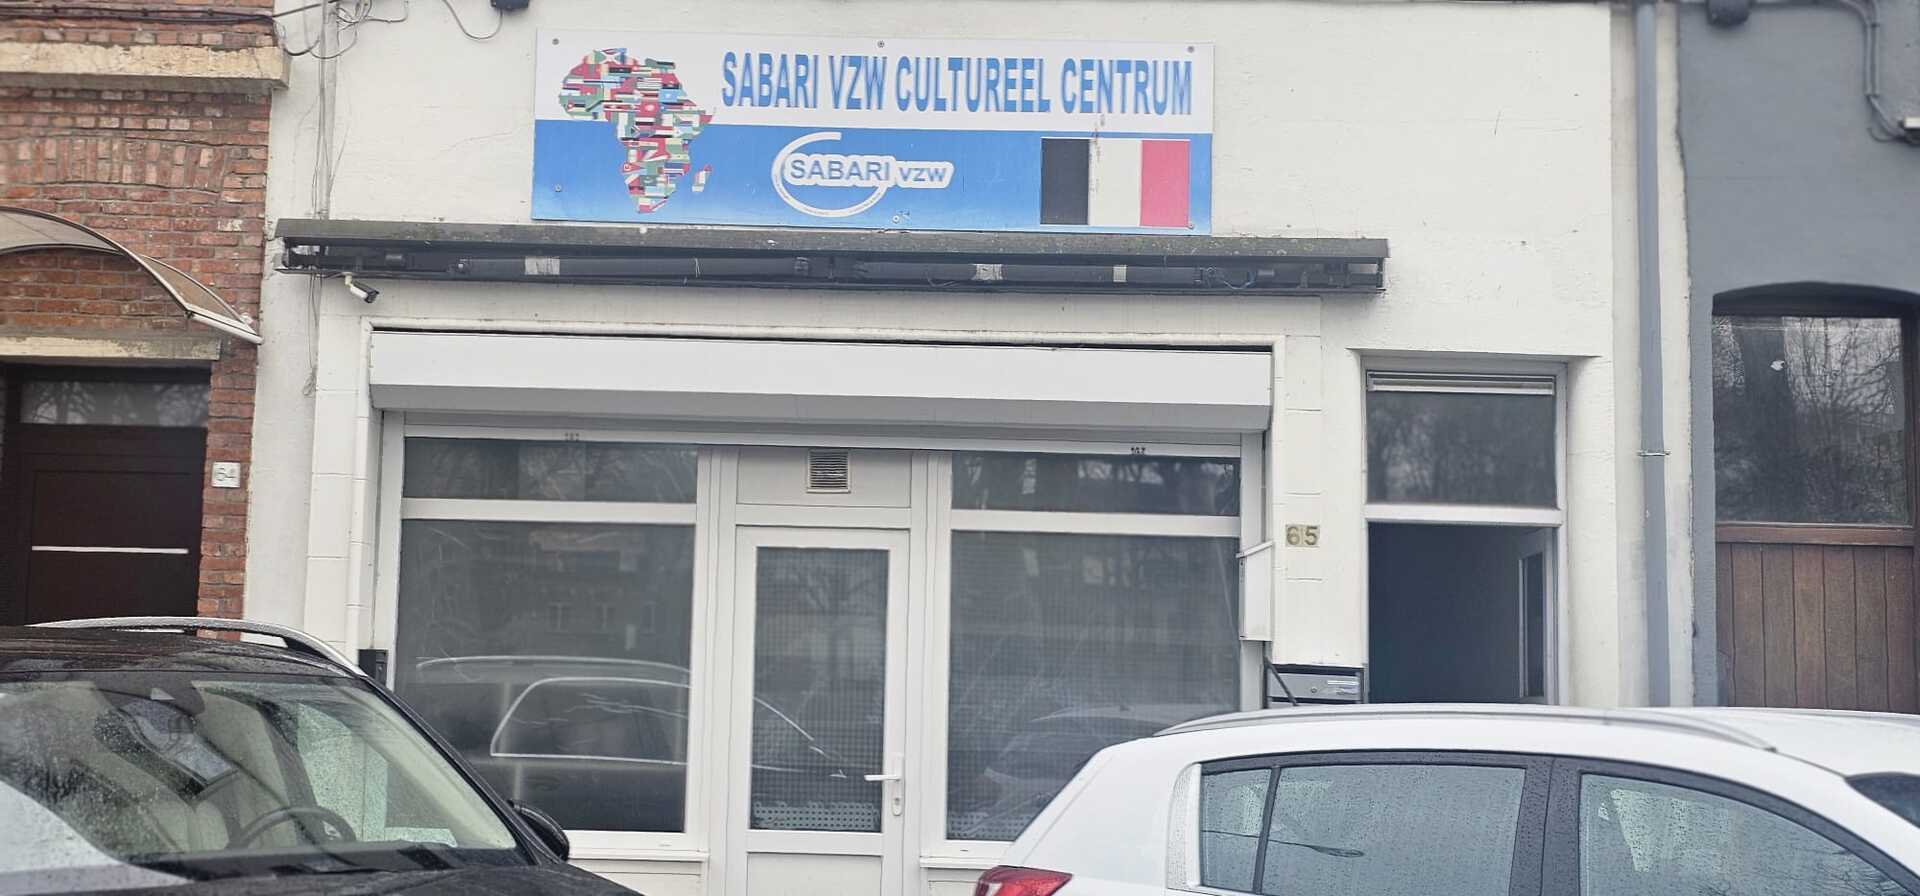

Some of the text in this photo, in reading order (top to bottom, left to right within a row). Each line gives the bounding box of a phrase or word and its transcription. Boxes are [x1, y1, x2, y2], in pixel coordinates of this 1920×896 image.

[722, 51, 1192, 115] SABARI VZW CULTUREEL CENTRUM
[790, 159, 889, 181] SABARI
[1287, 526, 1318, 546] 65
